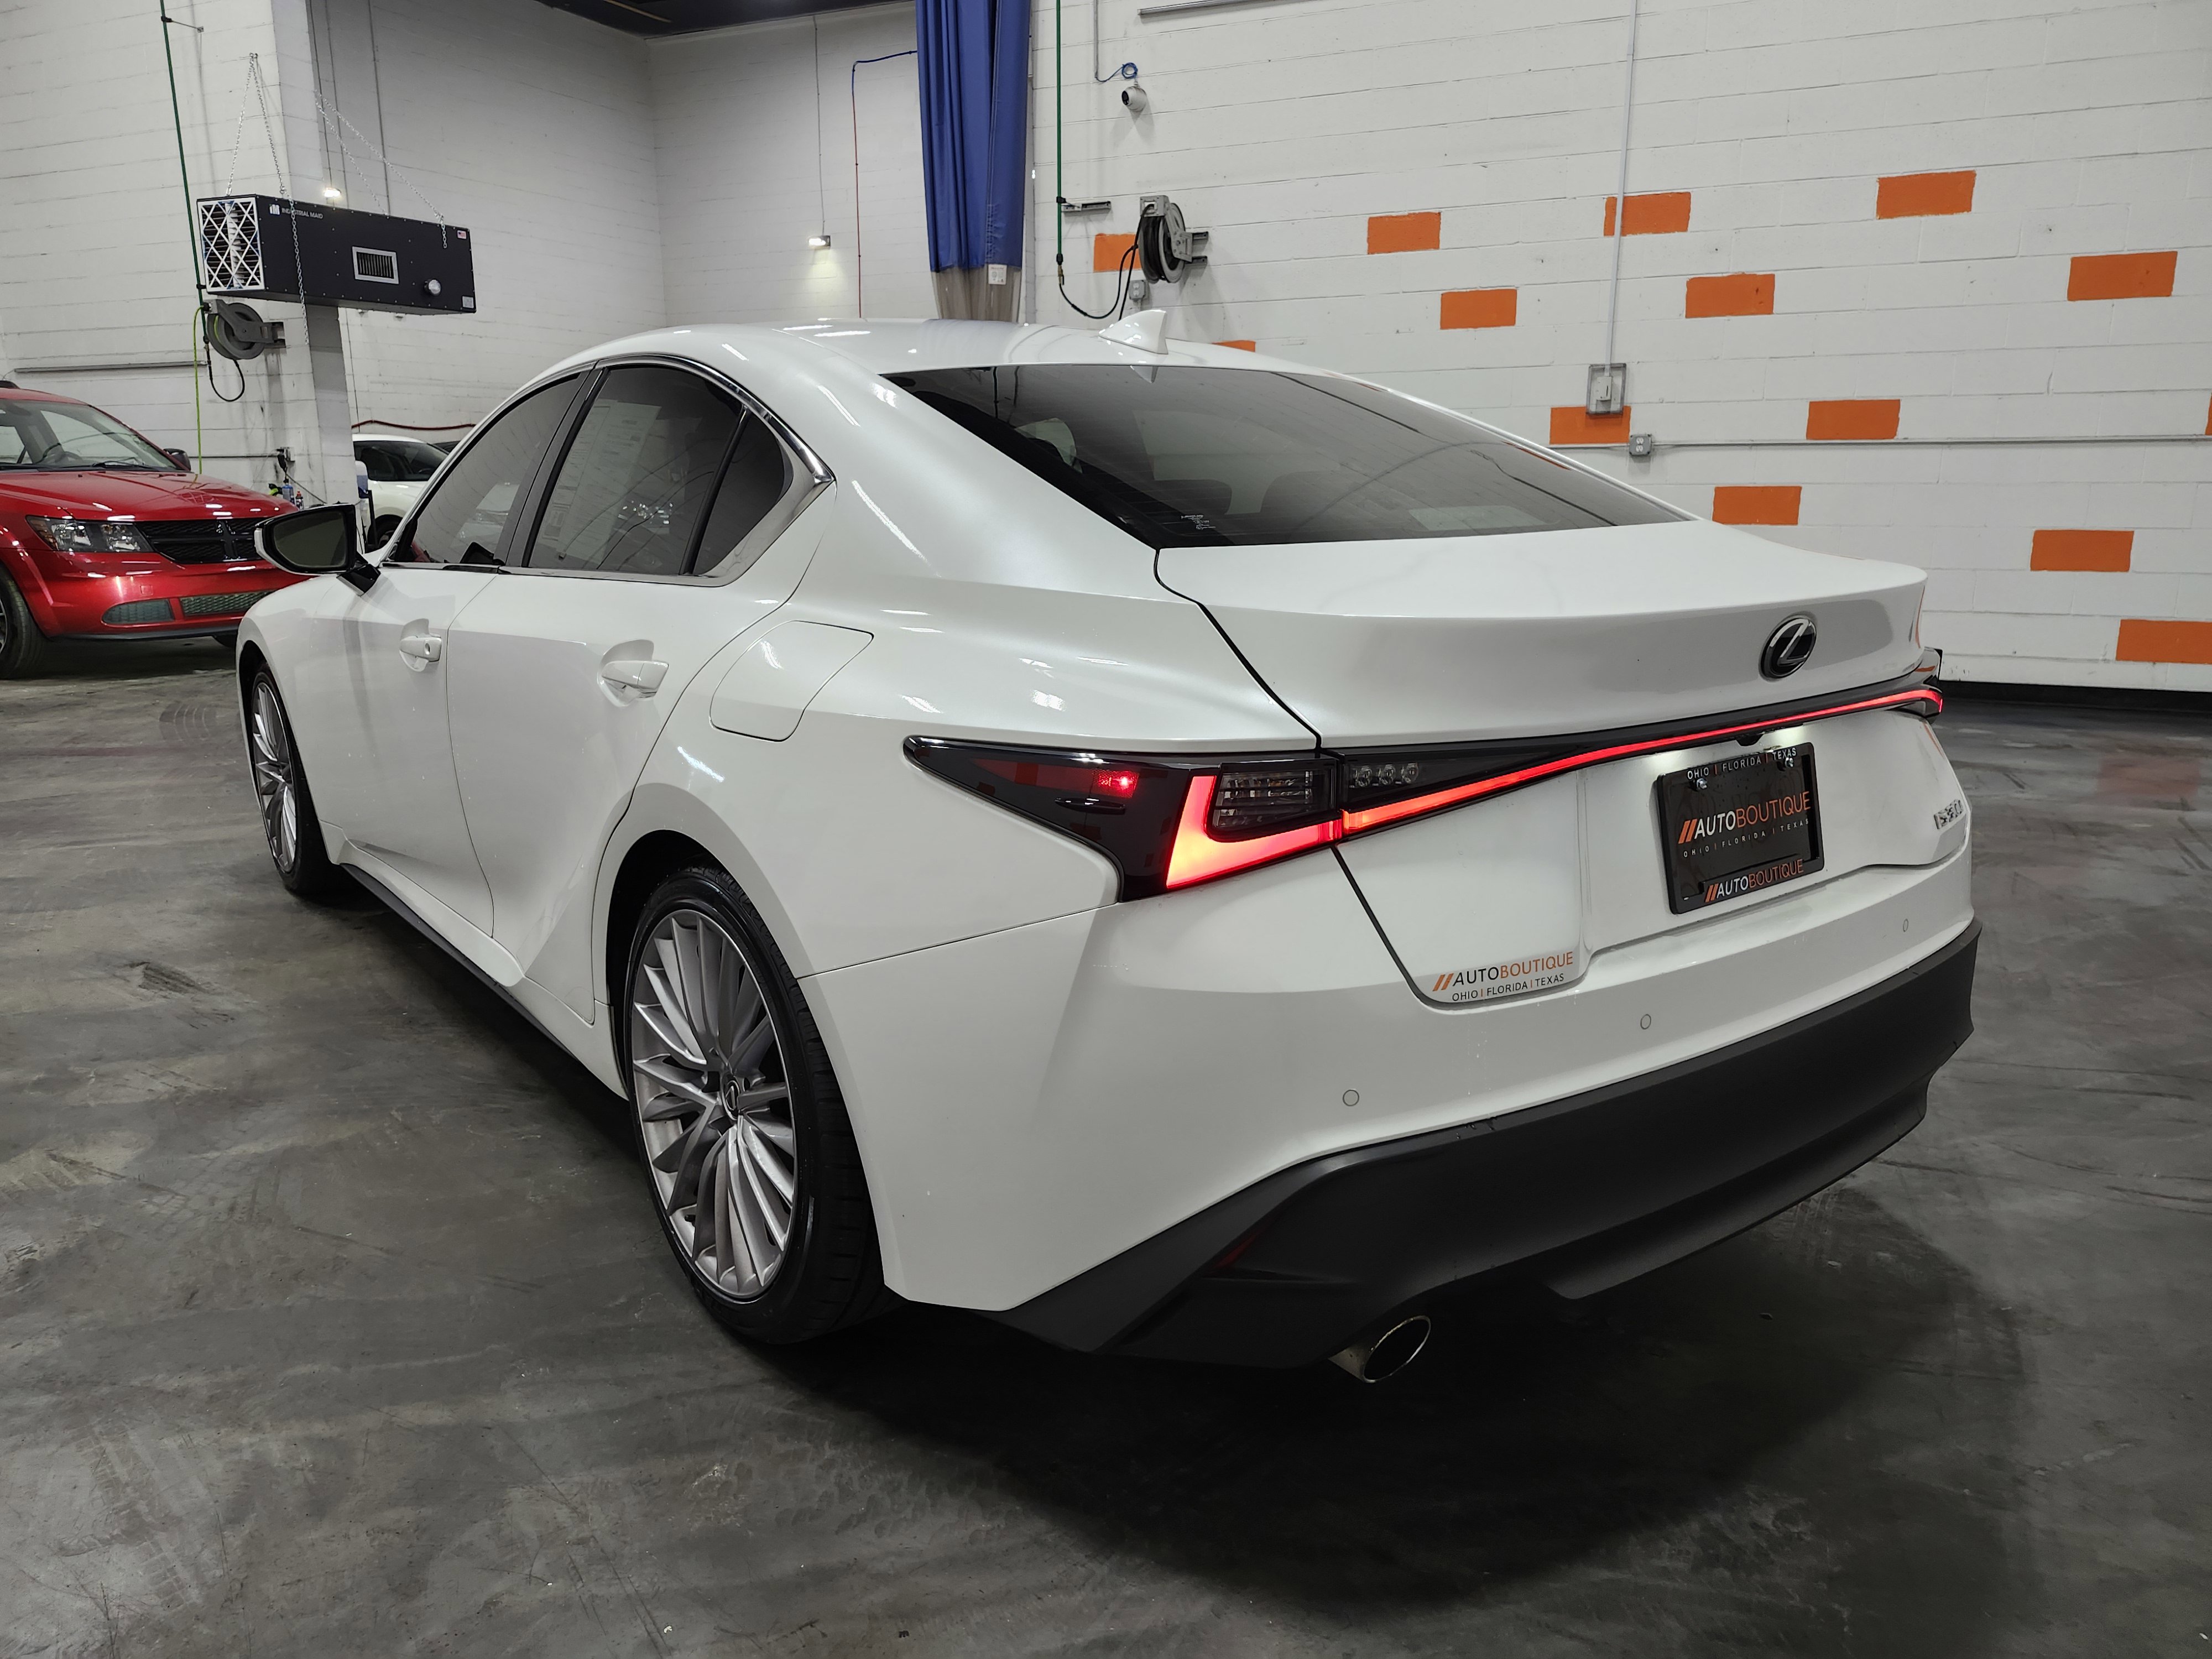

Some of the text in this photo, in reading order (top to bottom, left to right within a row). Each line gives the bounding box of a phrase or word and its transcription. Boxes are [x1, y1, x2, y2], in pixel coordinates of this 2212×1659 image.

[281, 207, 309, 217] INDSTRIAL
[1687, 747, 1797, 780] OHIO FLORIDA TEXAS
[1694, 791, 1811, 839] AUTOBOUTIQUE
[1683, 818, 1809, 858] OHIO FLORIDA TEXAS
[1716, 858, 1804, 899] AUTOBOUTIQUE
[1452, 951, 1573, 987] AUTOBOUTIQUE
[1452, 973, 1564, 1001] OHIO FLORIDA TEXAS
